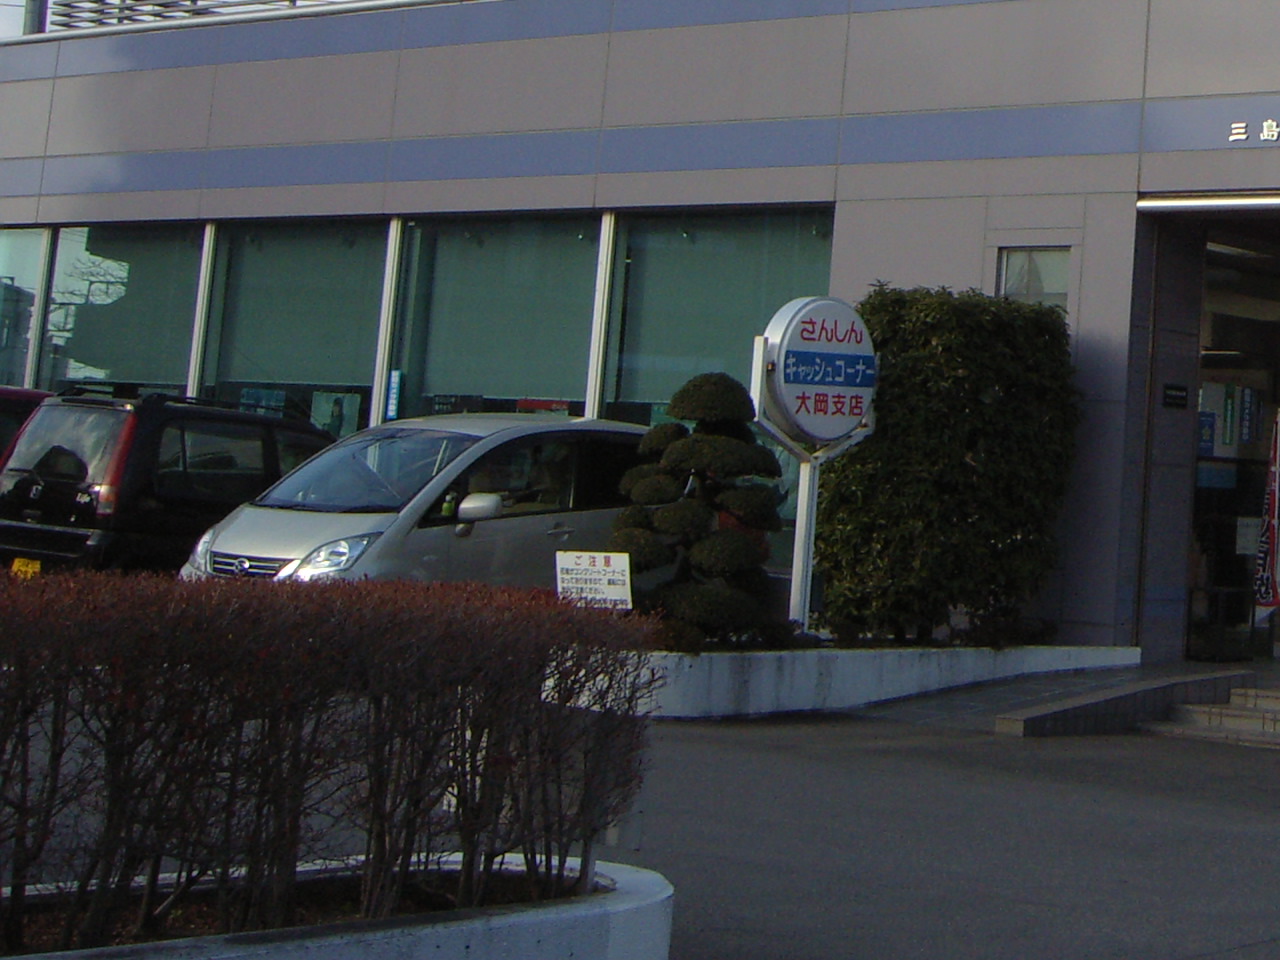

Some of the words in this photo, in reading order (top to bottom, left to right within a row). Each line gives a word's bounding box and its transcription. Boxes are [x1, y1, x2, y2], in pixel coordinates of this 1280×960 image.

[800, 318, 863, 344] さんしん
[786, 354, 875, 383] キャッシュコーナー
[795, 392, 864, 416] 大岡支店
